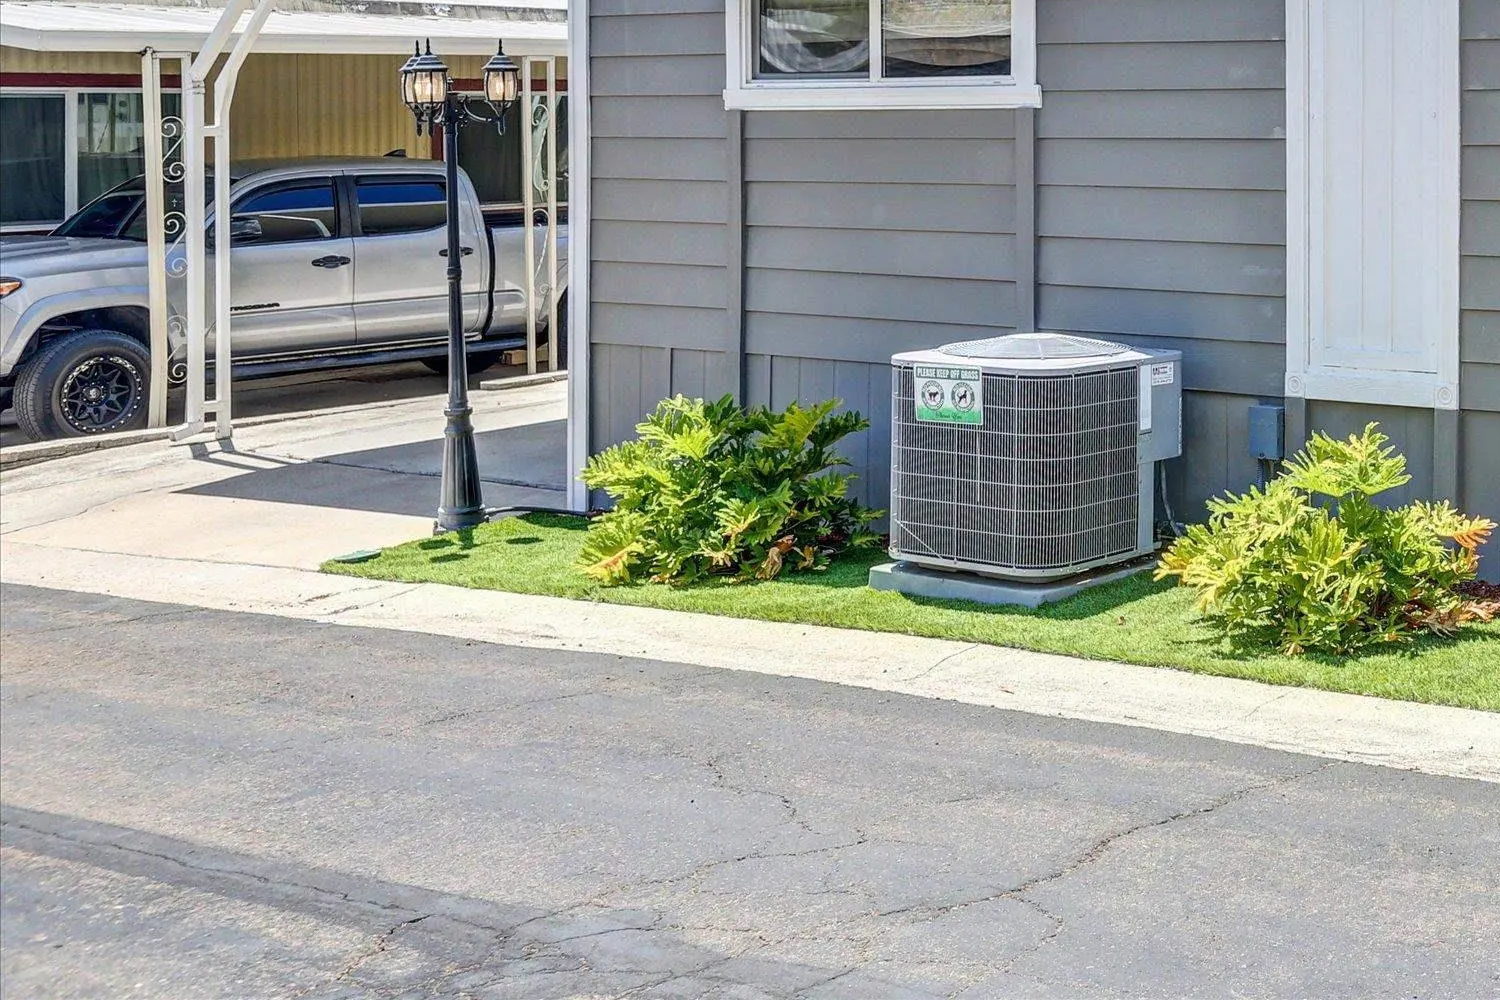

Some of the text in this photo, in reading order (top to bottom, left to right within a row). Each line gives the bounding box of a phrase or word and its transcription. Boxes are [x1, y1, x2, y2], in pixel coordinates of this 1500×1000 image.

[917, 366, 936, 378] PLEASE
[936, 368, 950, 379] KEEP
[950, 369, 960, 380] OFF
